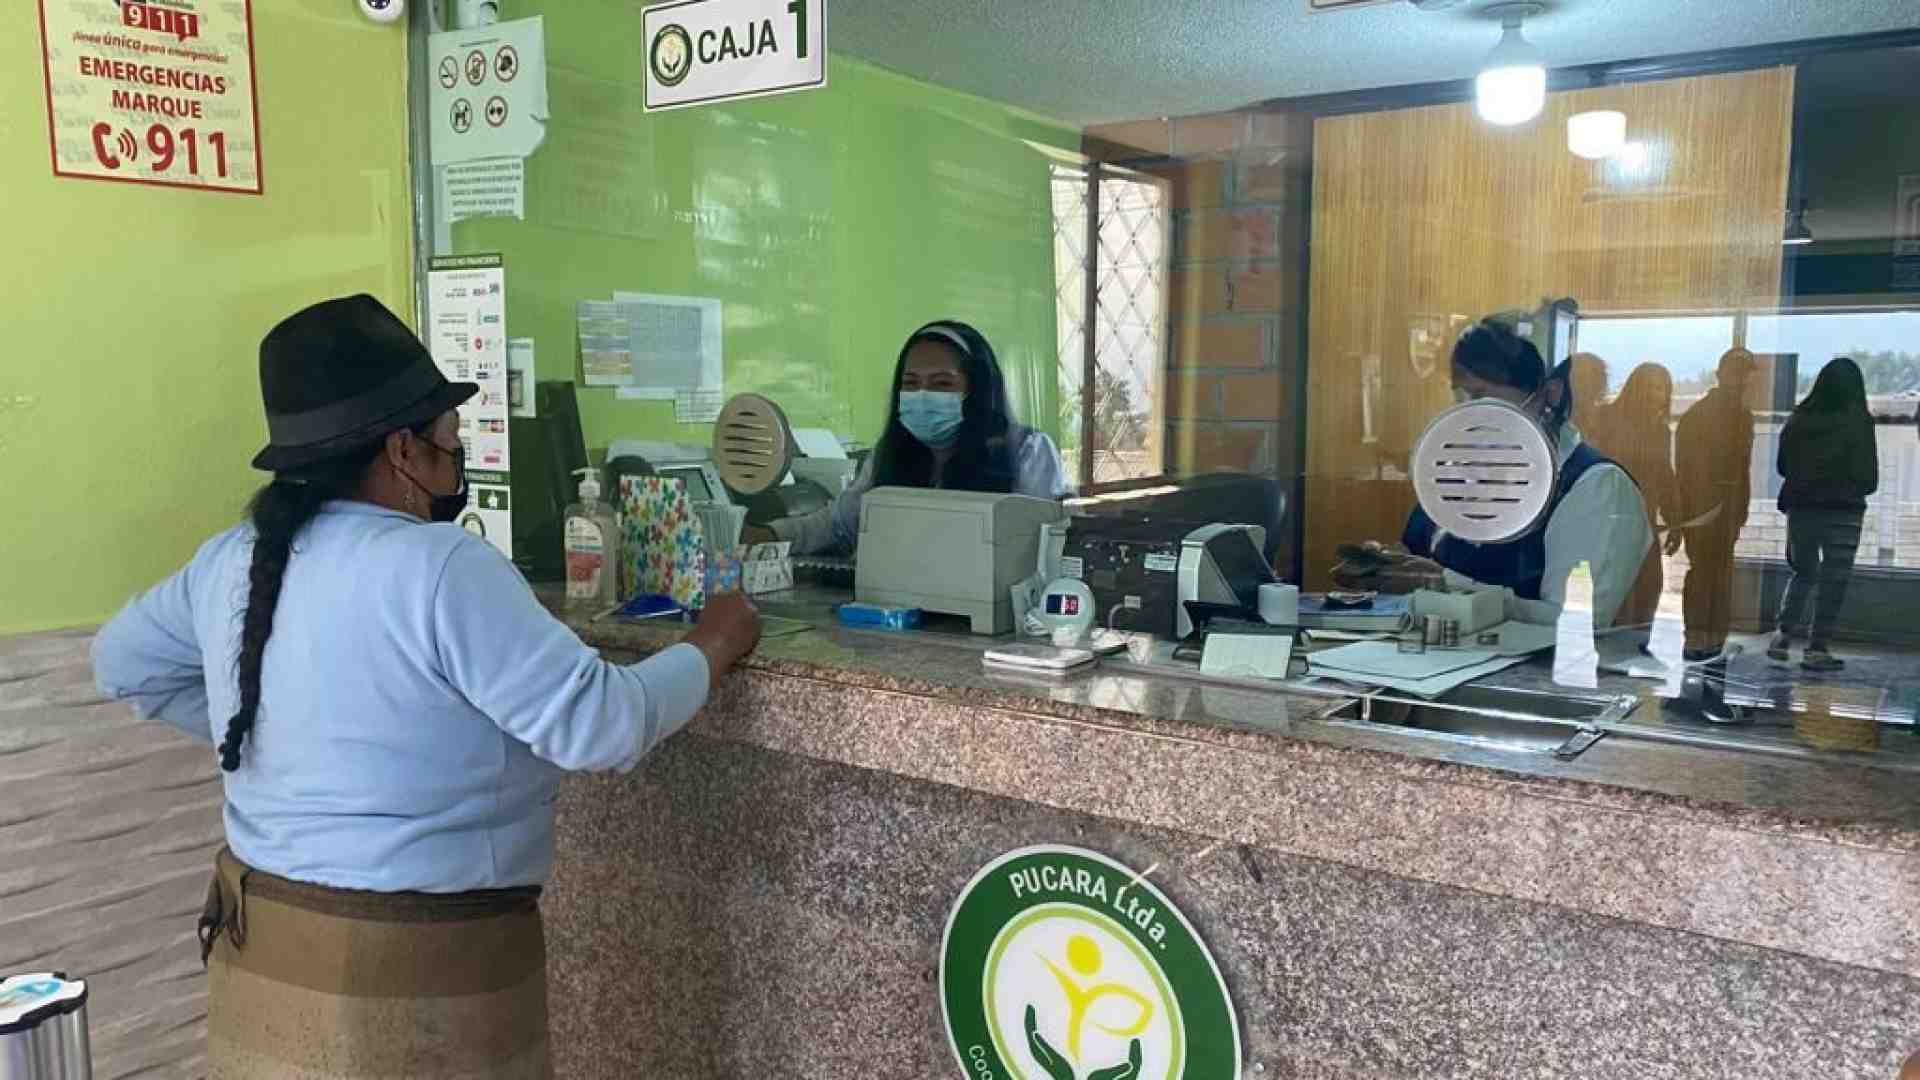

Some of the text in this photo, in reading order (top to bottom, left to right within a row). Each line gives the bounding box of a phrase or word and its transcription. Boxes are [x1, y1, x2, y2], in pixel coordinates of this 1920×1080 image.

[128, 5, 191, 35] 911
[698, 0, 808, 64] CAJA 1
[79, 56, 226, 94] EMERGENCIAS
[111, 90, 202, 119] MARQUE
[146, 123, 226, 177] 911
[1009, 865, 1166, 949] PUCARA Ltda.
